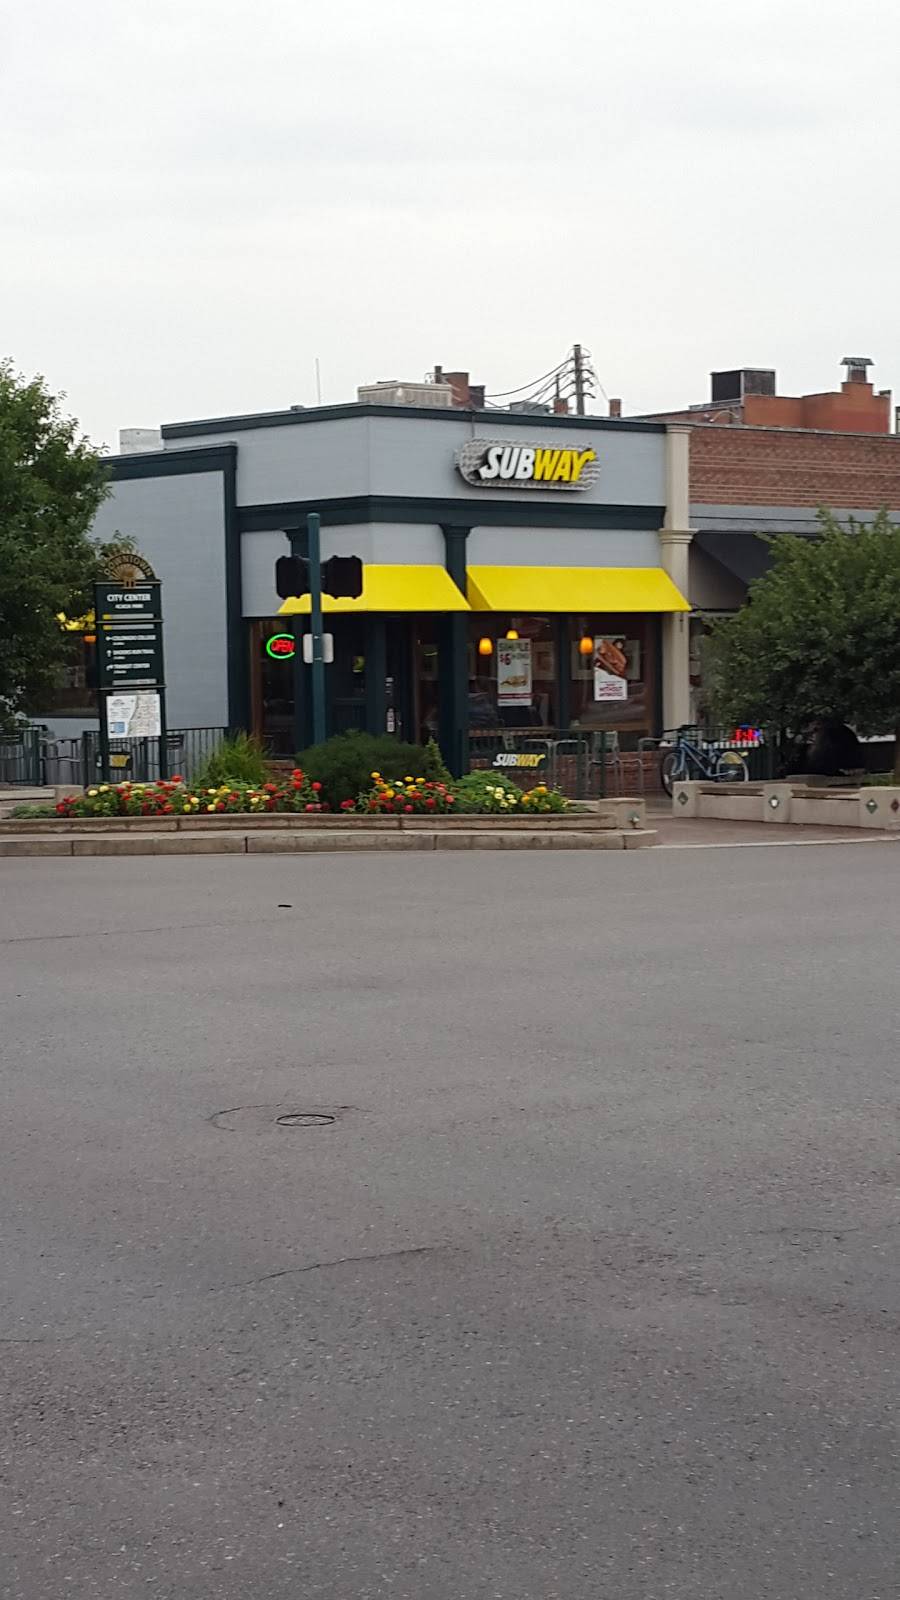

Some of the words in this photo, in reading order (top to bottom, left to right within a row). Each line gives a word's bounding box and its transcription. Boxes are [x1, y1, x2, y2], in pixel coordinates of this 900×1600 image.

[478, 447, 597, 482] SUBWAY
[107, 594, 123, 602] CITY
[124, 593, 151, 602] CENTER
[492, 753, 546, 767] SUBWAY
